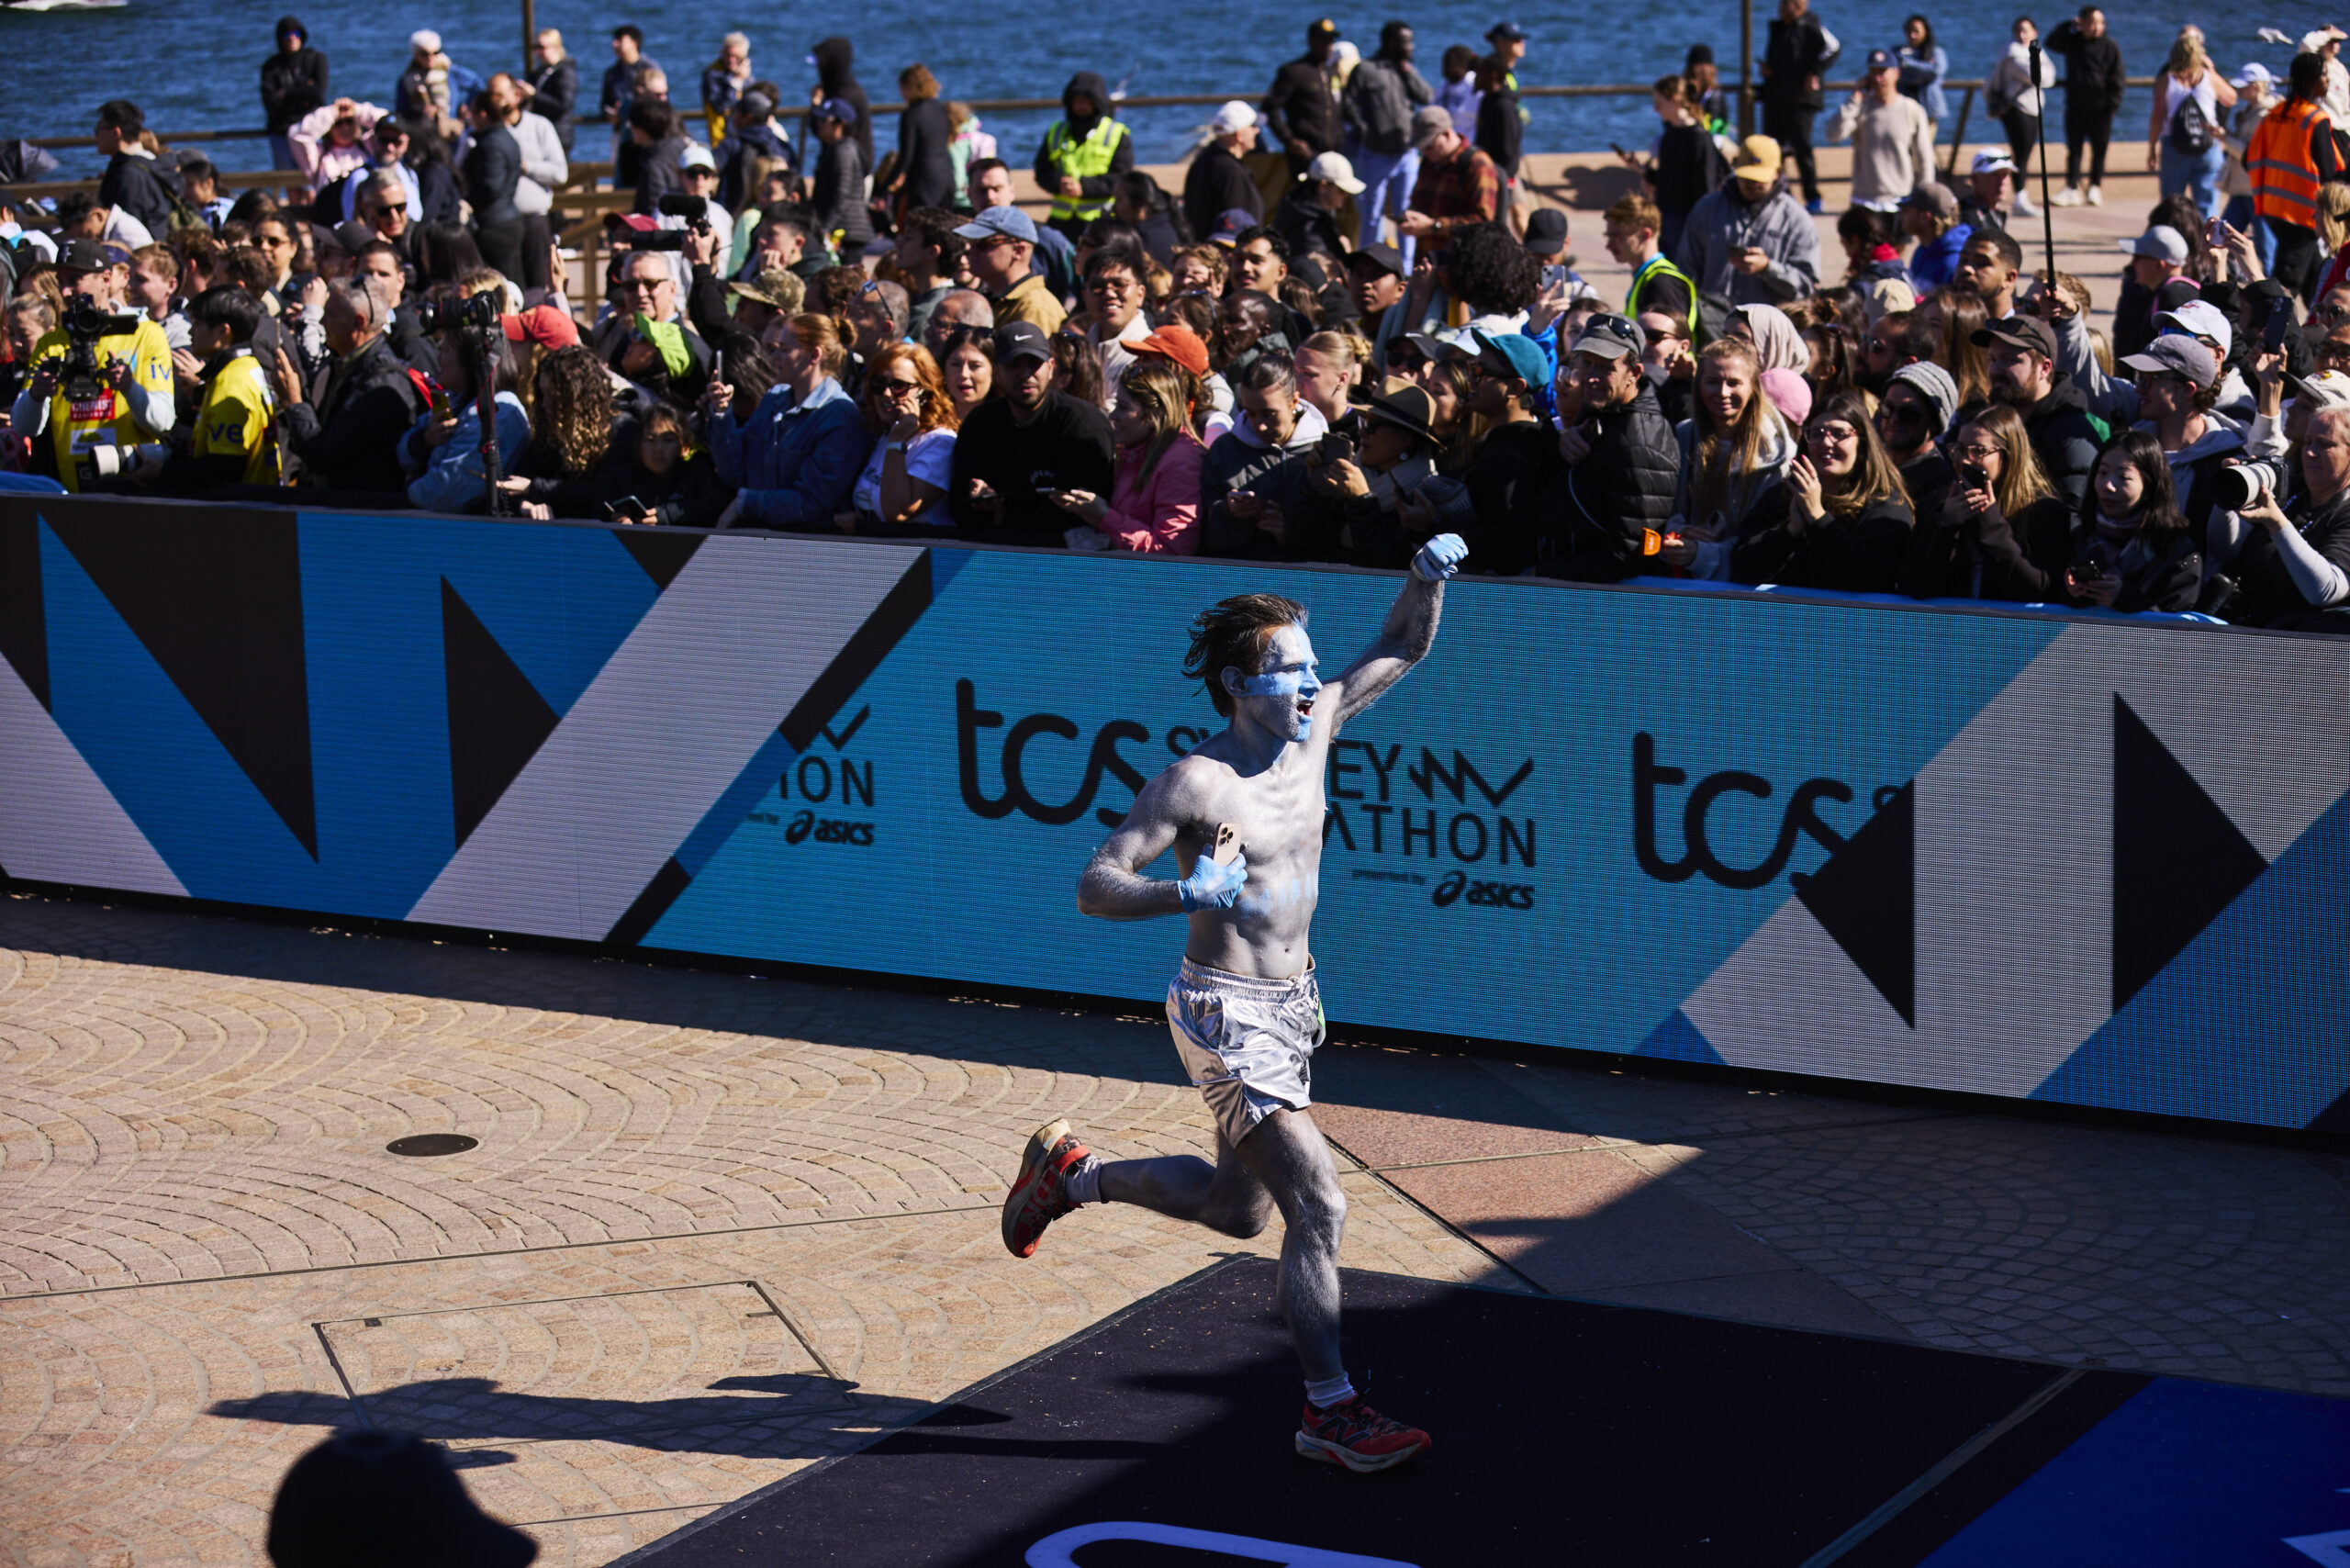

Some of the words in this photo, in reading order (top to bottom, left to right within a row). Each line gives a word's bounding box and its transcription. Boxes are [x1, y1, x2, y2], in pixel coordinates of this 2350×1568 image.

[956, 677, 1151, 827] tcs
[813, 818, 874, 846] asics
[1466, 879, 1535, 910] asics
